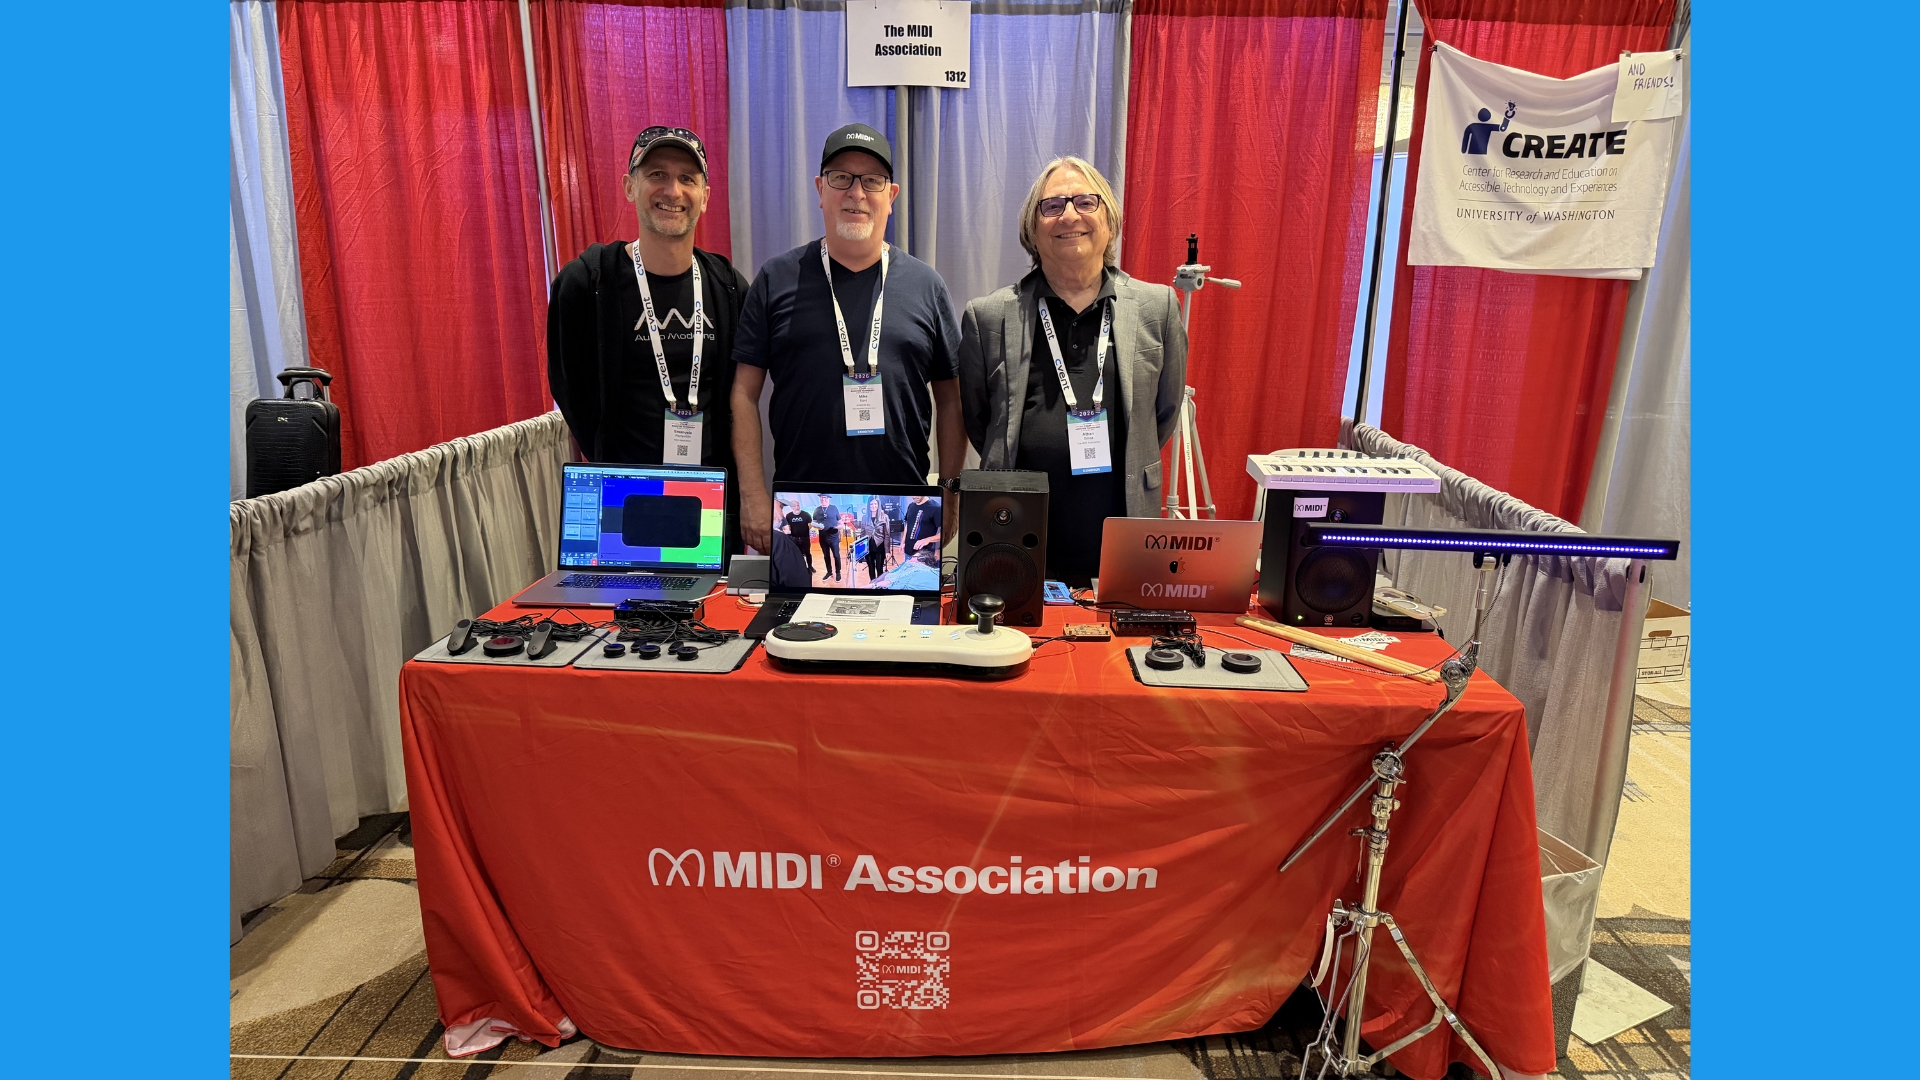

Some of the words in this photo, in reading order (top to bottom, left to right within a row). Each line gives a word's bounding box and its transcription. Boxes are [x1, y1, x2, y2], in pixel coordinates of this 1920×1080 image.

[884, 25, 904, 37] The
[907, 24, 932, 38] MIDI
[875, 43, 941, 56] Association
[1627, 63, 1645, 76] AND
[945, 71, 966, 82] 1312
[1633, 77, 1674, 90] FRIENDS!
[1502, 129, 1627, 159] CREATE
[1463, 165, 1491, 177] Center
[1492, 166, 1505, 178] for
[1505, 167, 1543, 180] Research
[1544, 169, 1560, 180] and
[1562, 166, 1606, 180] Education
[1606, 168, 1617, 177] on
[1459, 180, 1500, 193] Accessible
[1503, 182, 1549, 196] Technology
[1550, 182, 1567, 194] and
[1570, 181, 1617, 194] Experiences
[1456, 208, 1523, 221] UNIVERSITY
[1526, 212, 1539, 224] of
[1543, 209, 1615, 221] WASHINGTON
[634, 333, 666, 341] Auo
[843, 854, 1158, 895] Association
[896, 965, 921, 974] MIDI
